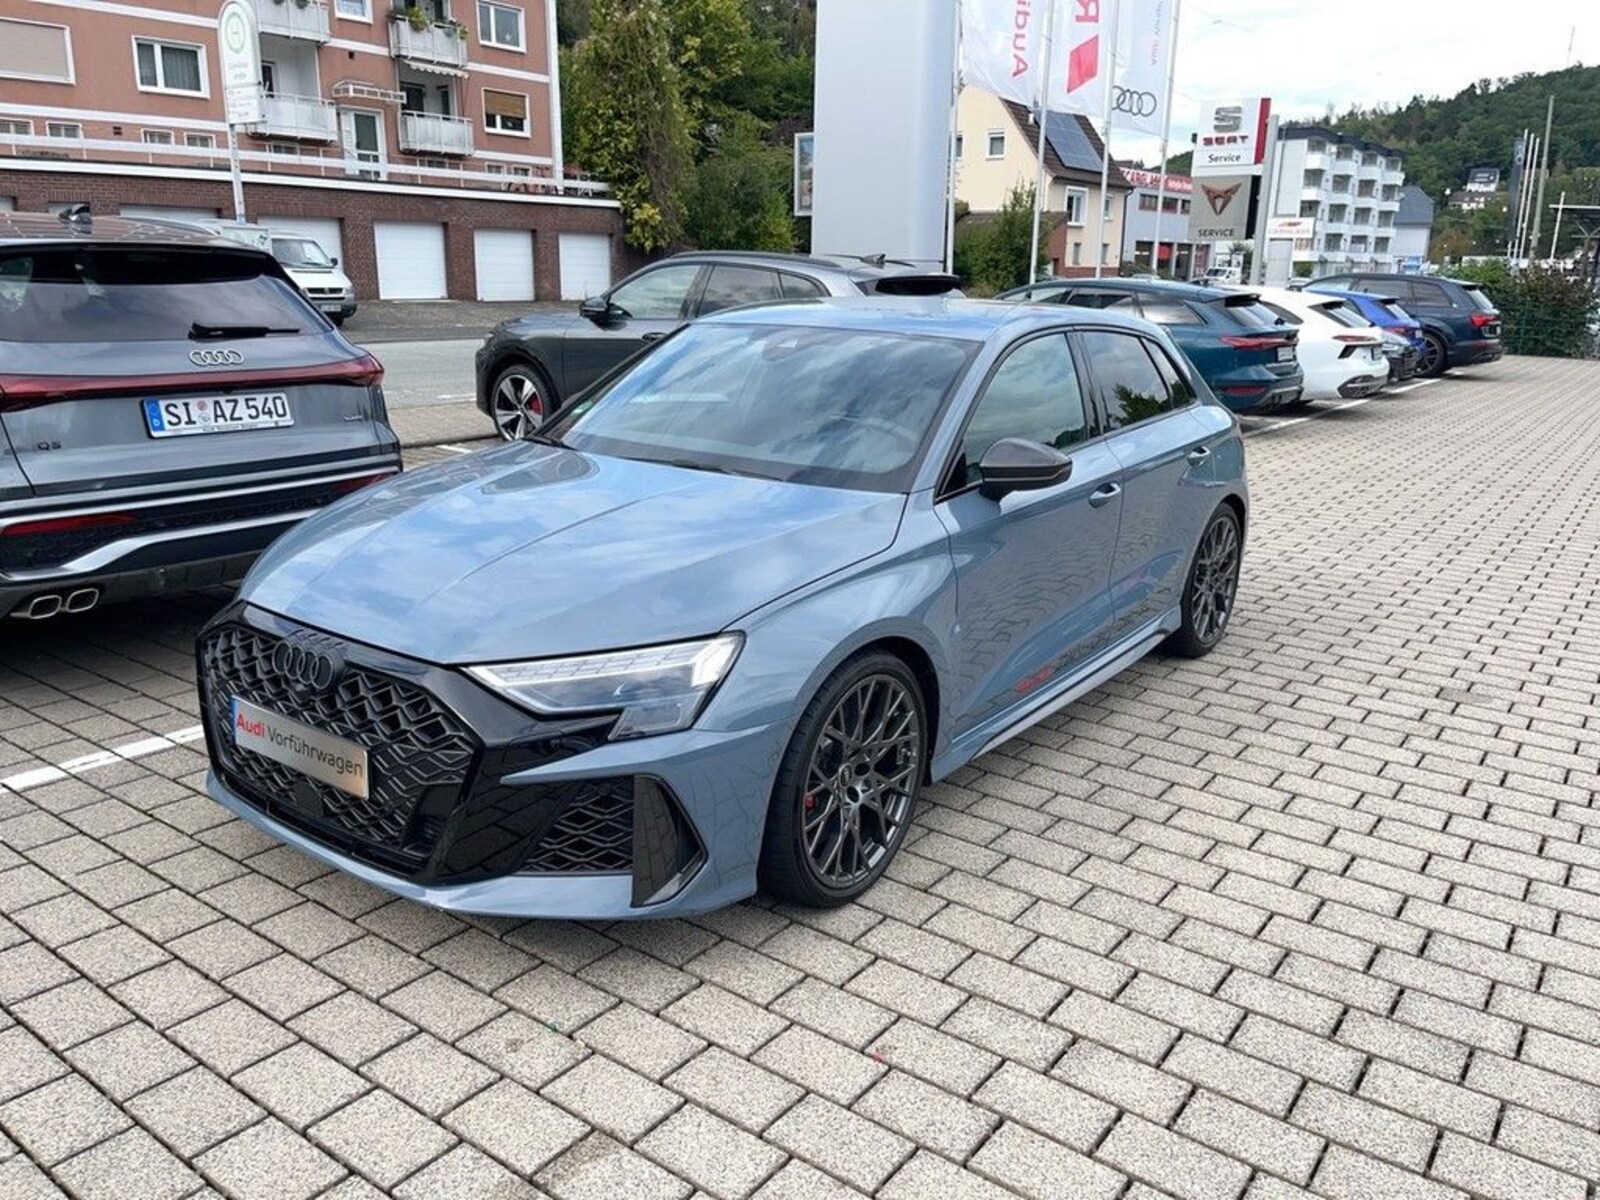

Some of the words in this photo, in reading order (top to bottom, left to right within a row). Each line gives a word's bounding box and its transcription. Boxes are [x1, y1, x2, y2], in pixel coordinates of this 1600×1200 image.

[1203, 135, 1249, 146] SEAT
[1208, 153, 1241, 163] Service
[1197, 227, 1235, 238] SERVICE
[165, 402, 196, 426] SI
[213, 398, 243, 423] AZ
[245, 396, 287, 420] 540
[236, 713, 265, 738] Audi
[267, 726, 363, 778] Vorführwagen
